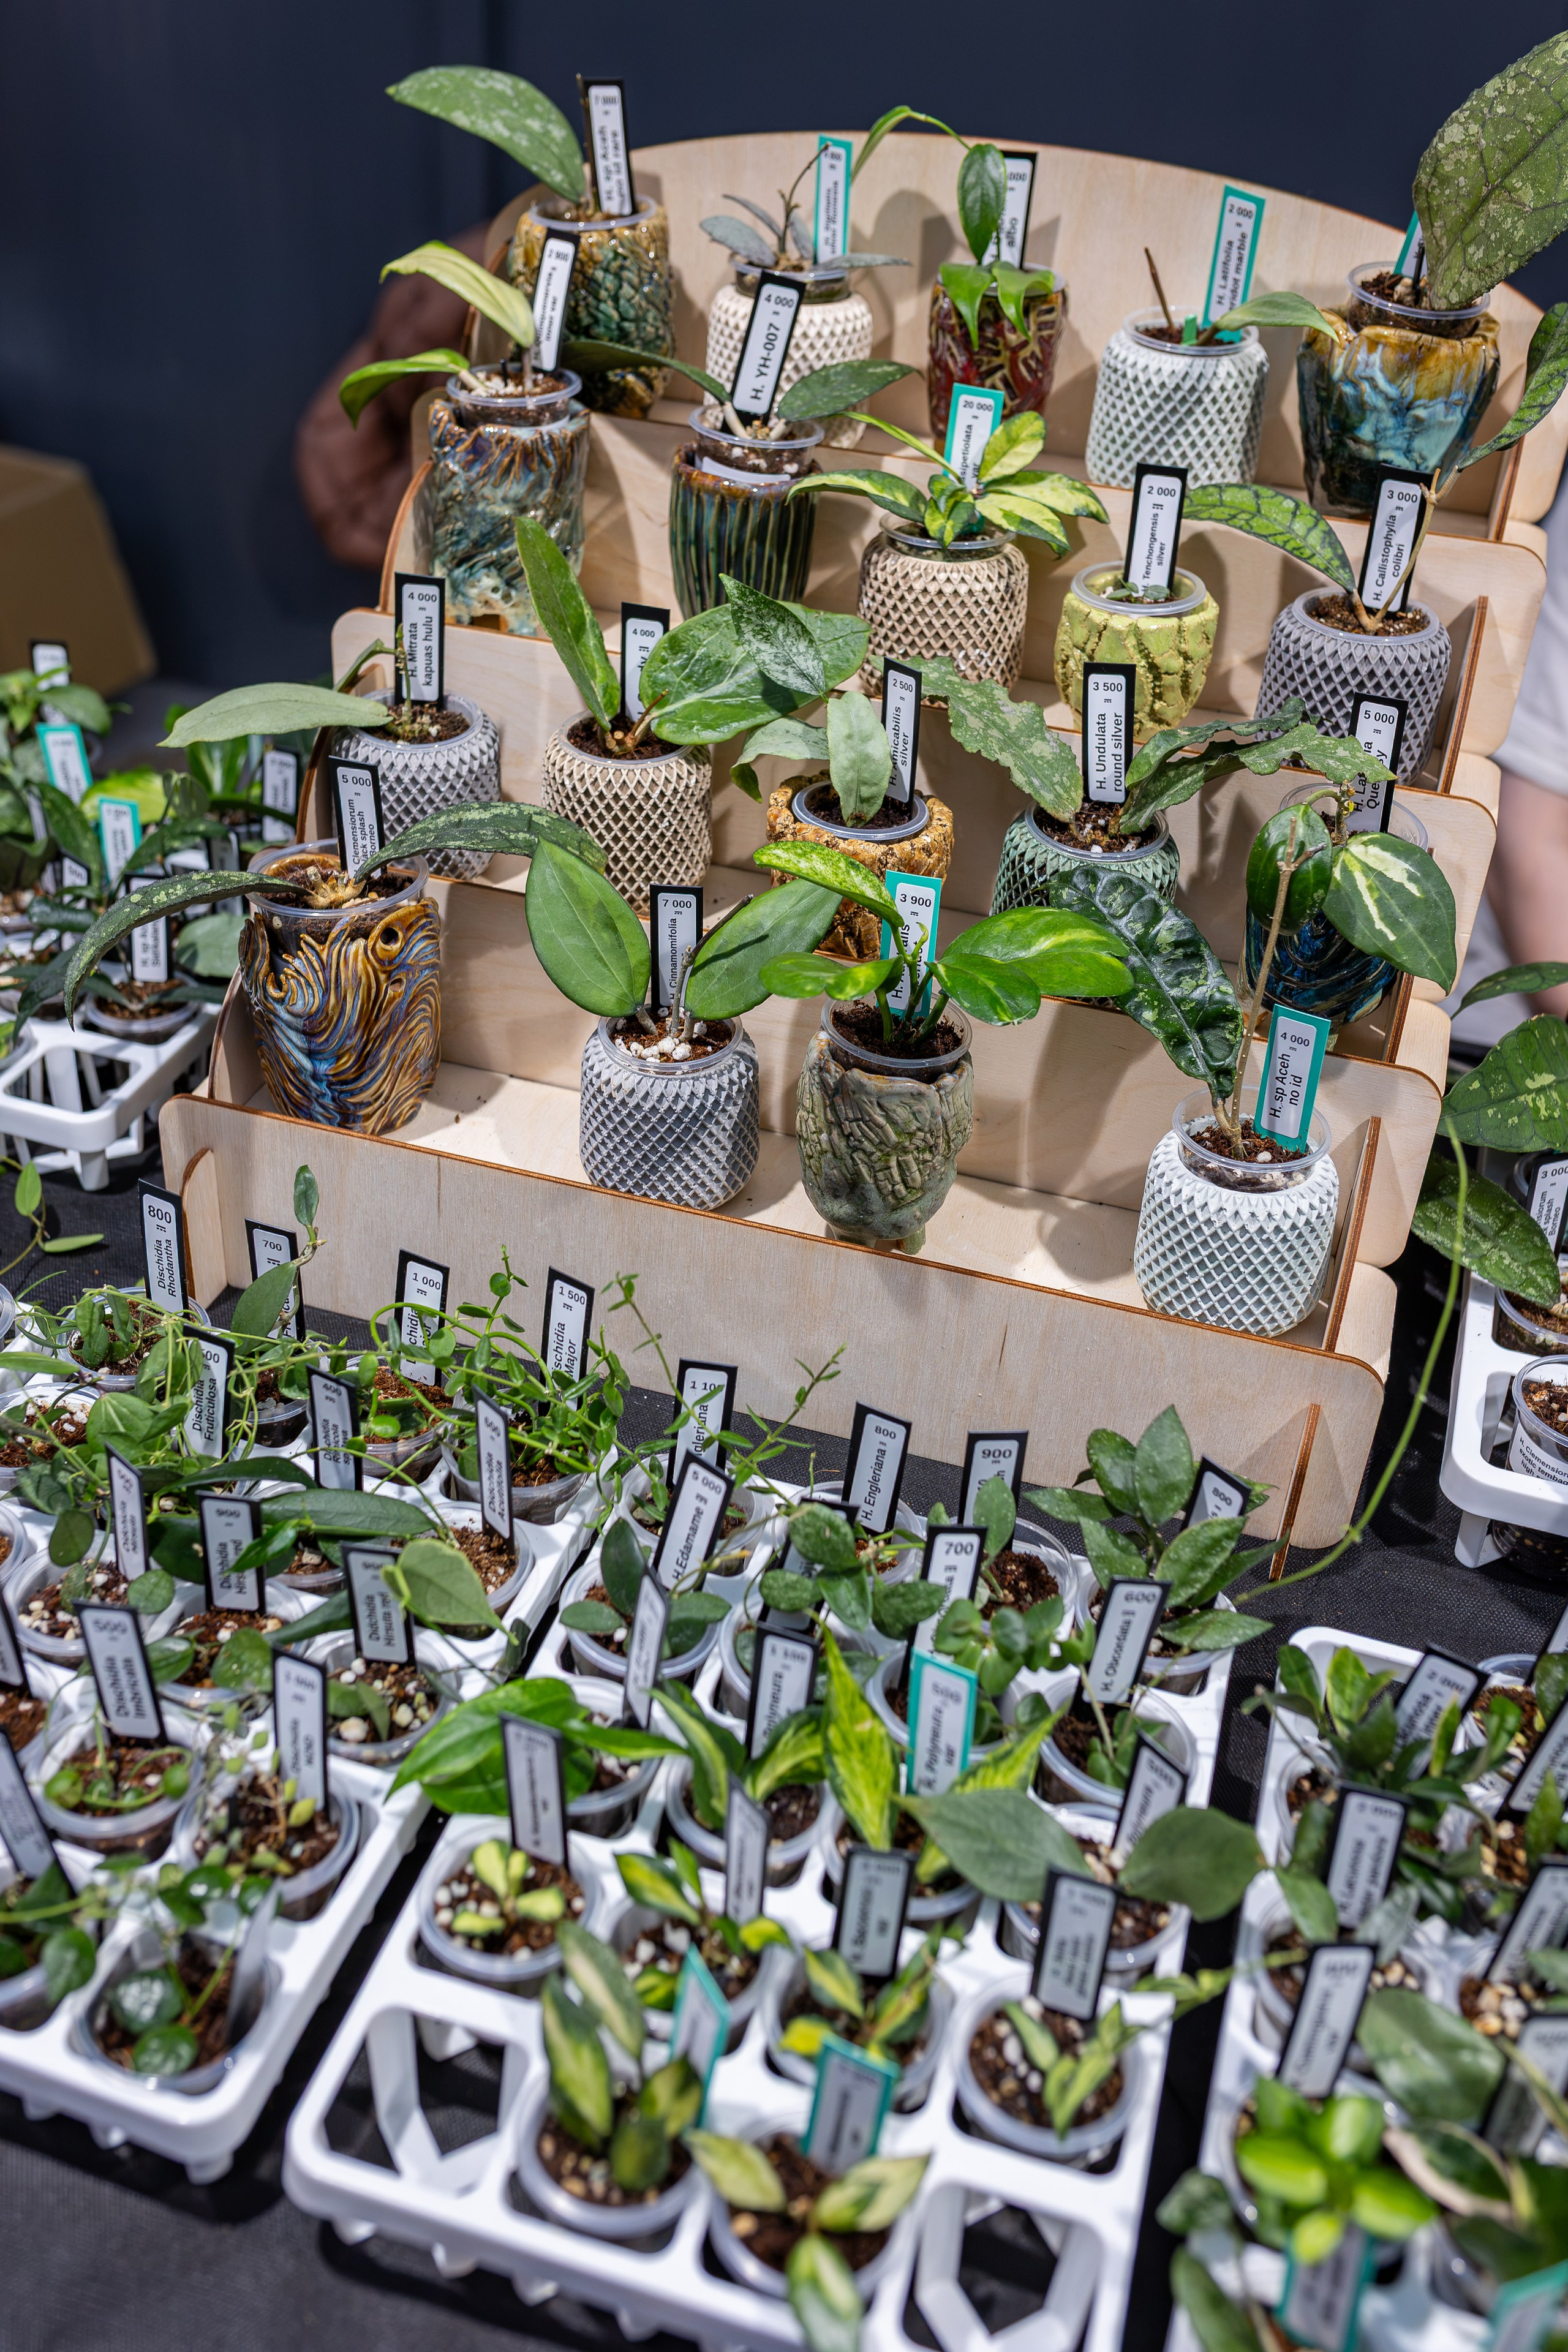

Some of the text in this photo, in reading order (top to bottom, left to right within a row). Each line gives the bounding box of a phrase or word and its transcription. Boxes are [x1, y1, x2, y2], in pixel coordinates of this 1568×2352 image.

[1006, 217, 1019, 247] albo
[1219, 239, 1234, 287] Latifolia
[1229, 232, 1248, 312] eridot marble
[764, 295, 795, 309] 4 000
[750, 322, 781, 401] H. YH-007
[963, 400, 993, 412] 20 000
[1147, 486, 1176, 497] 2 000
[1387, 490, 1419, 504] 3 000
[1143, 513, 1160, 581] Tenchongensis
[1156, 542, 1166, 567] silver
[1373, 514, 1398, 602] H. Callistophylla
[1392, 543, 1406, 578] colibri
[409, 592, 438, 603] 4 000
[640, 629, 655, 638] 000
[409, 622, 418, 679] H. Mitrata
[424, 615, 434, 687] kapuas hulu
[892, 678, 913, 693] 2 500
[1093, 682, 1123, 692] 3 500
[1363, 710, 1395, 725] 5 000
[889, 706, 902, 786] H. Amicabilis
[900, 733, 909, 767] silver
[1095, 713, 1106, 790] H. Undulata
[1112, 712, 1122, 793] round silver
[342, 775, 372, 788] 5 000
[1354, 798, 1364, 812] H.
[349, 799, 360, 865] Clemensiorum
[359, 811, 369, 842] splash
[662, 899, 692, 910] 7 000
[900, 893, 932, 908] 3 900
[669, 918, 677, 989] Cinnamomifolia
[891, 985, 903, 999] H.
[1281, 1032, 1311, 1047] 4 000
[1269, 1054, 1291, 1119] H. sp Aceh
[1289, 1075, 1303, 1107] no id
[1541, 1170, 1548, 1179] 3
[148, 1204, 173, 1224] 800
[1544, 1197, 1555, 1225] splash
[1548, 1207, 1561, 1236] Borneo
[262, 1239, 283, 1253] 700
[155, 1239, 167, 1289] Dischidia
[168, 1239, 176, 1297] Rhodantha
[412, 1272, 442, 1291] 1 000
[559, 1286, 586, 1305] 1 500
[552, 1322, 566, 1371] ischidia
[565, 1339, 578, 1377] Major
[690, 1381, 696, 1389] 1
[192, 1379, 205, 1432] Dischidia
[204, 1378, 217, 1441] Fruticulosa
[692, 1404, 709, 1459] gleriana
[875, 1425, 897, 1440] 800
[1520, 1437, 1525, 1447] H.
[981, 1448, 1012, 1460] 900
[1520, 1448, 1536, 1468] exotic
[1521, 1460, 1535, 1476] high
[861, 1449, 888, 1521] H. Engleriana
[944, 1541, 974, 1556] 700
[1124, 1591, 1157, 1605] 600
